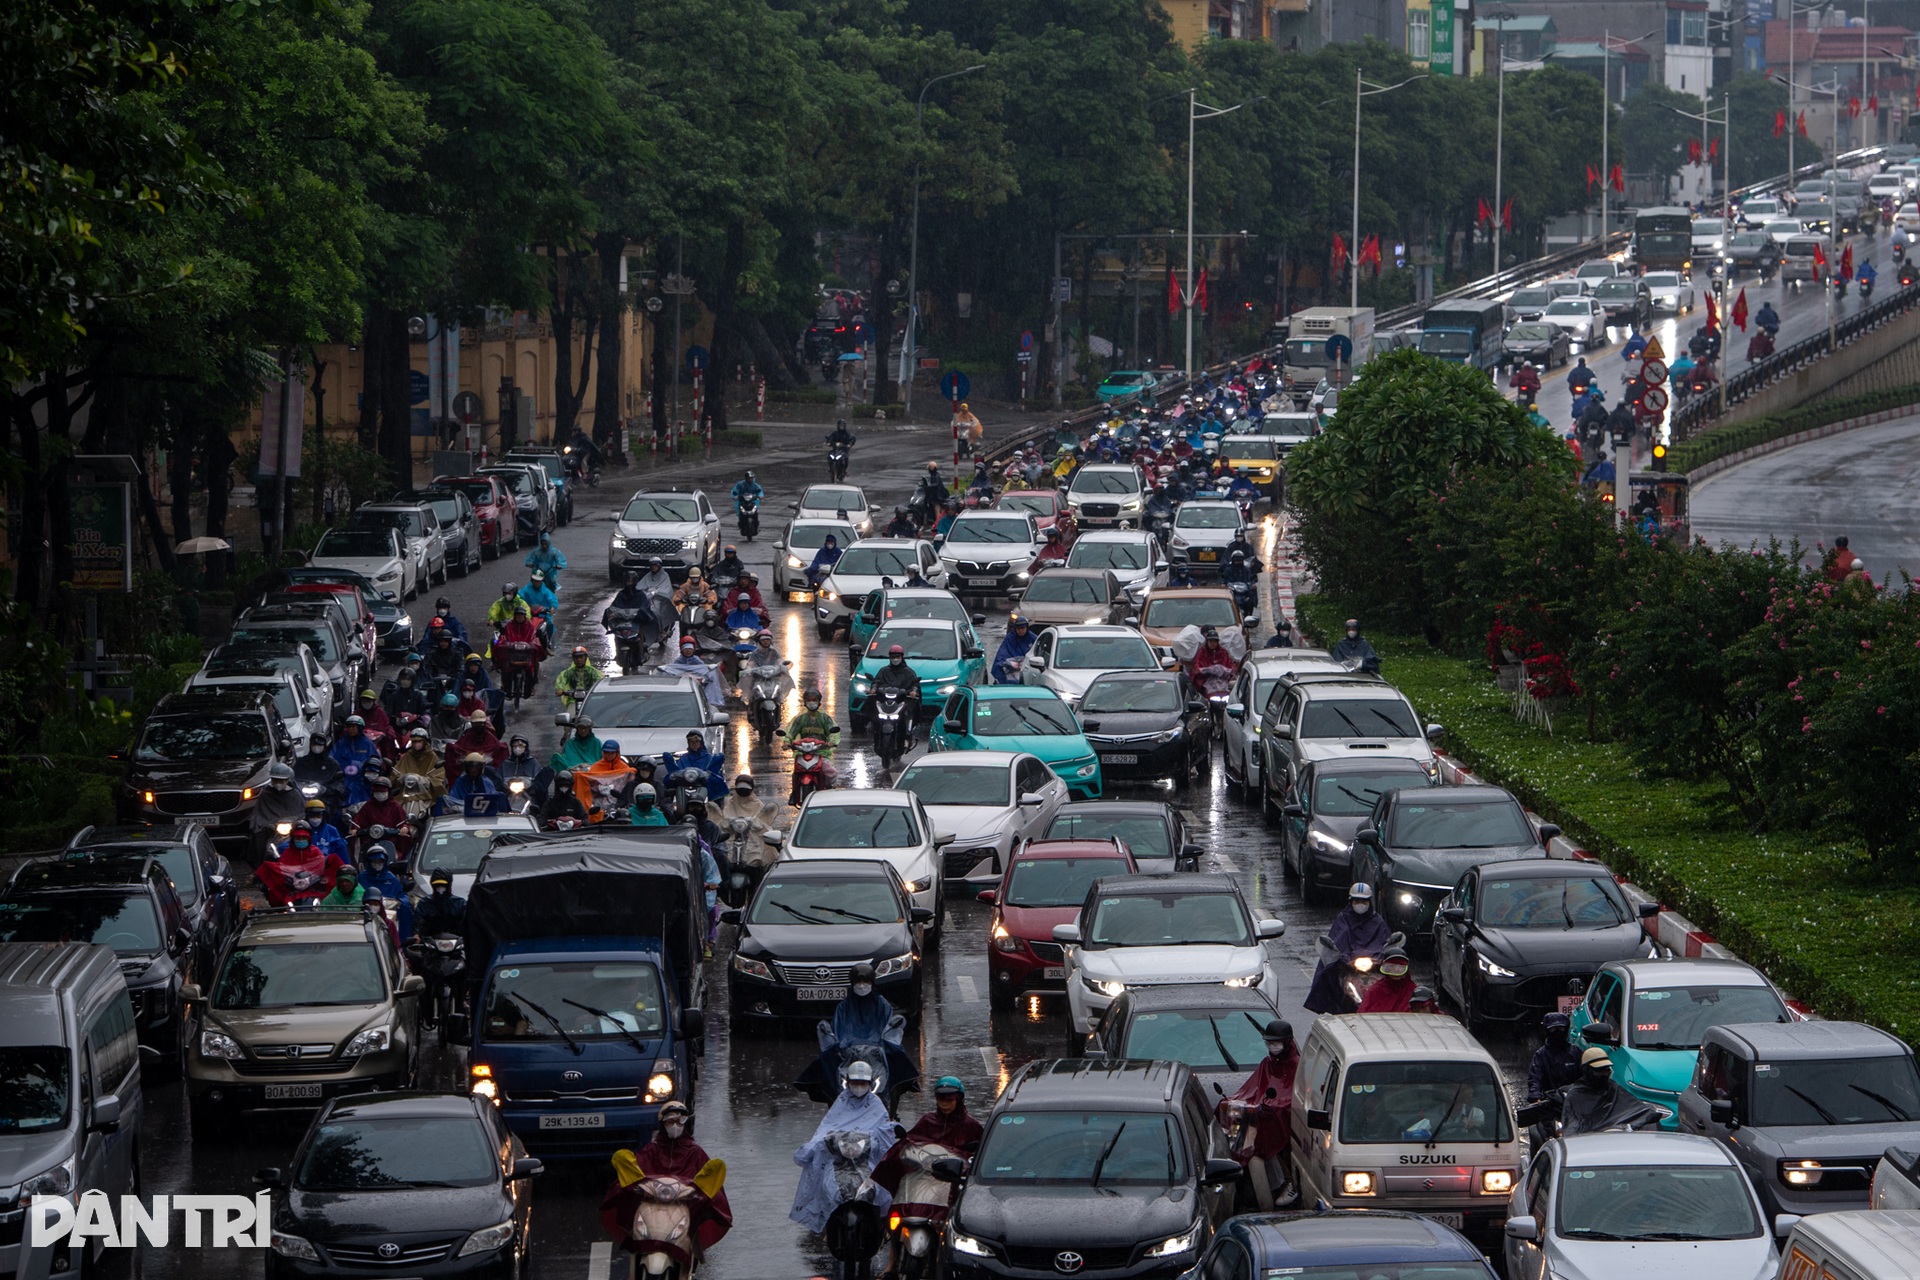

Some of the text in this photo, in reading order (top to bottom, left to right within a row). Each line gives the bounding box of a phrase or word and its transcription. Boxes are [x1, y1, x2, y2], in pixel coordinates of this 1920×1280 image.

[73, 527, 101, 542] Bia
[798, 989, 846, 999] 30A-078.33
[1636, 1023, 1659, 1031] TAXI
[266, 1086, 321, 1098] 30A-200.99
[544, 1116, 601, 1127] 29K-139.49
[1399, 1154, 1456, 1164] SUZUKI
